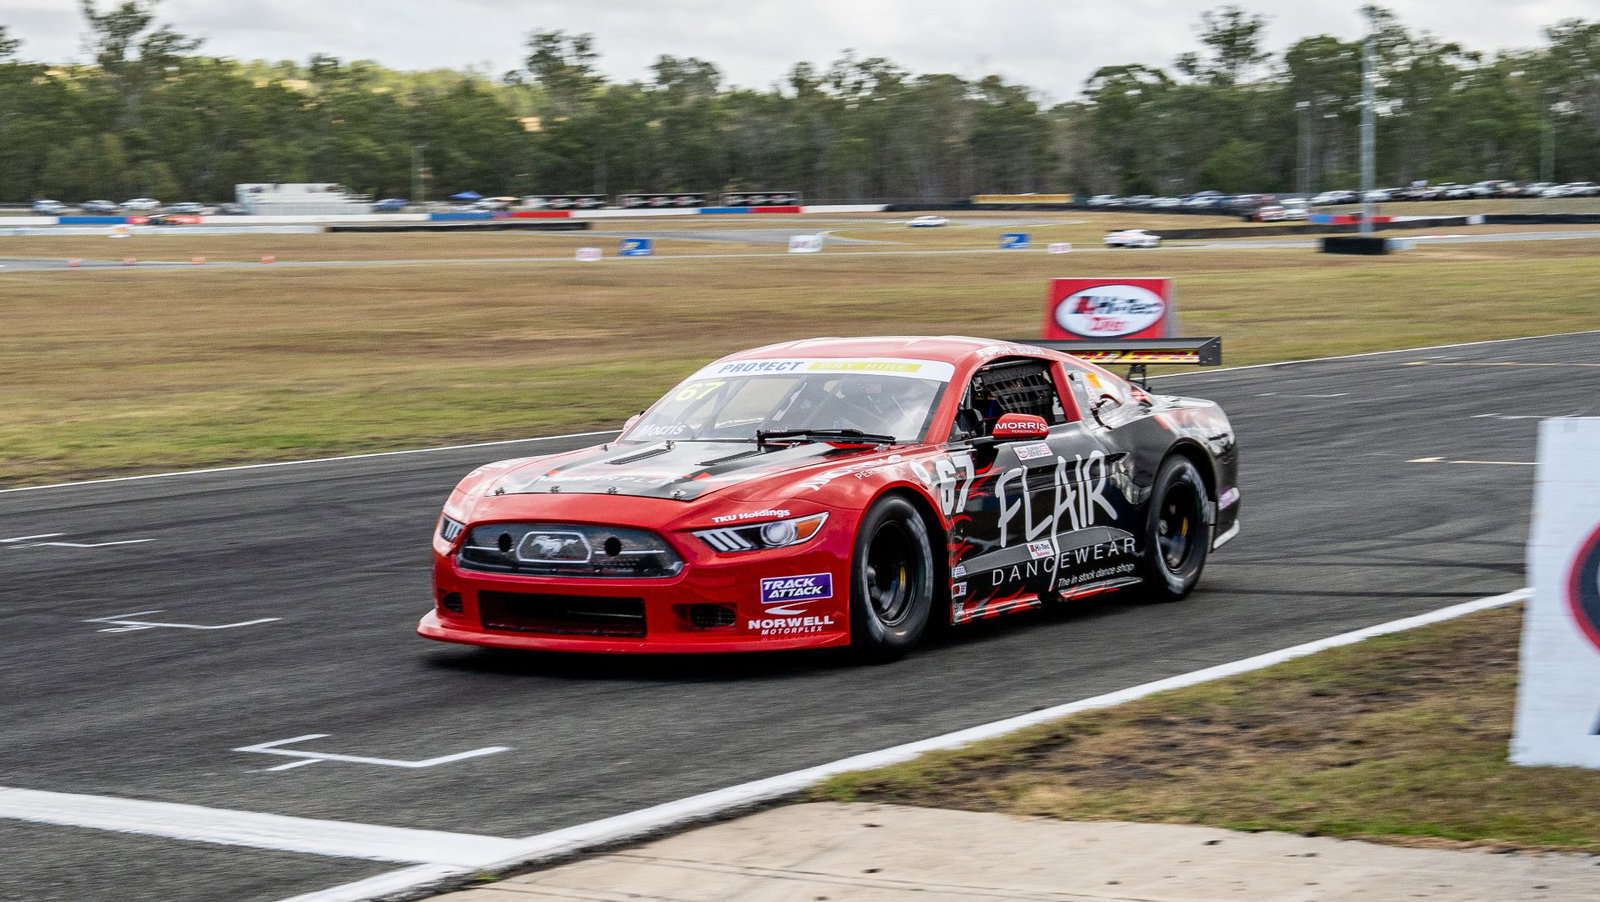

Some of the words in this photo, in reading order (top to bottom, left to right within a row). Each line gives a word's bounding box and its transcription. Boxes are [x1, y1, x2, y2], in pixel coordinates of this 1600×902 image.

[676, 381, 727, 401] 67
[637, 422, 687, 437] Morris
[995, 422, 1047, 432] MORRIS
[935, 454, 975, 515] 67
[712, 514, 737, 523] TKU
[740, 509, 791, 519] Holdings
[995, 450, 1118, 592] FLAIR
[992, 537, 1136, 586] DANCEWEAR
[1058, 577, 1070, 587] The
[1071, 575, 1078, 584] in
[1078, 570, 1095, 582] stock
[1096, 566, 1115, 578] dance
[1116, 563, 1135, 573] shop
[763, 577, 816, 590] TRACK
[768, 585, 824, 598] ATTACK
[748, 615, 834, 629] NORWELL
[761, 626, 823, 635] MOTORPLEX
